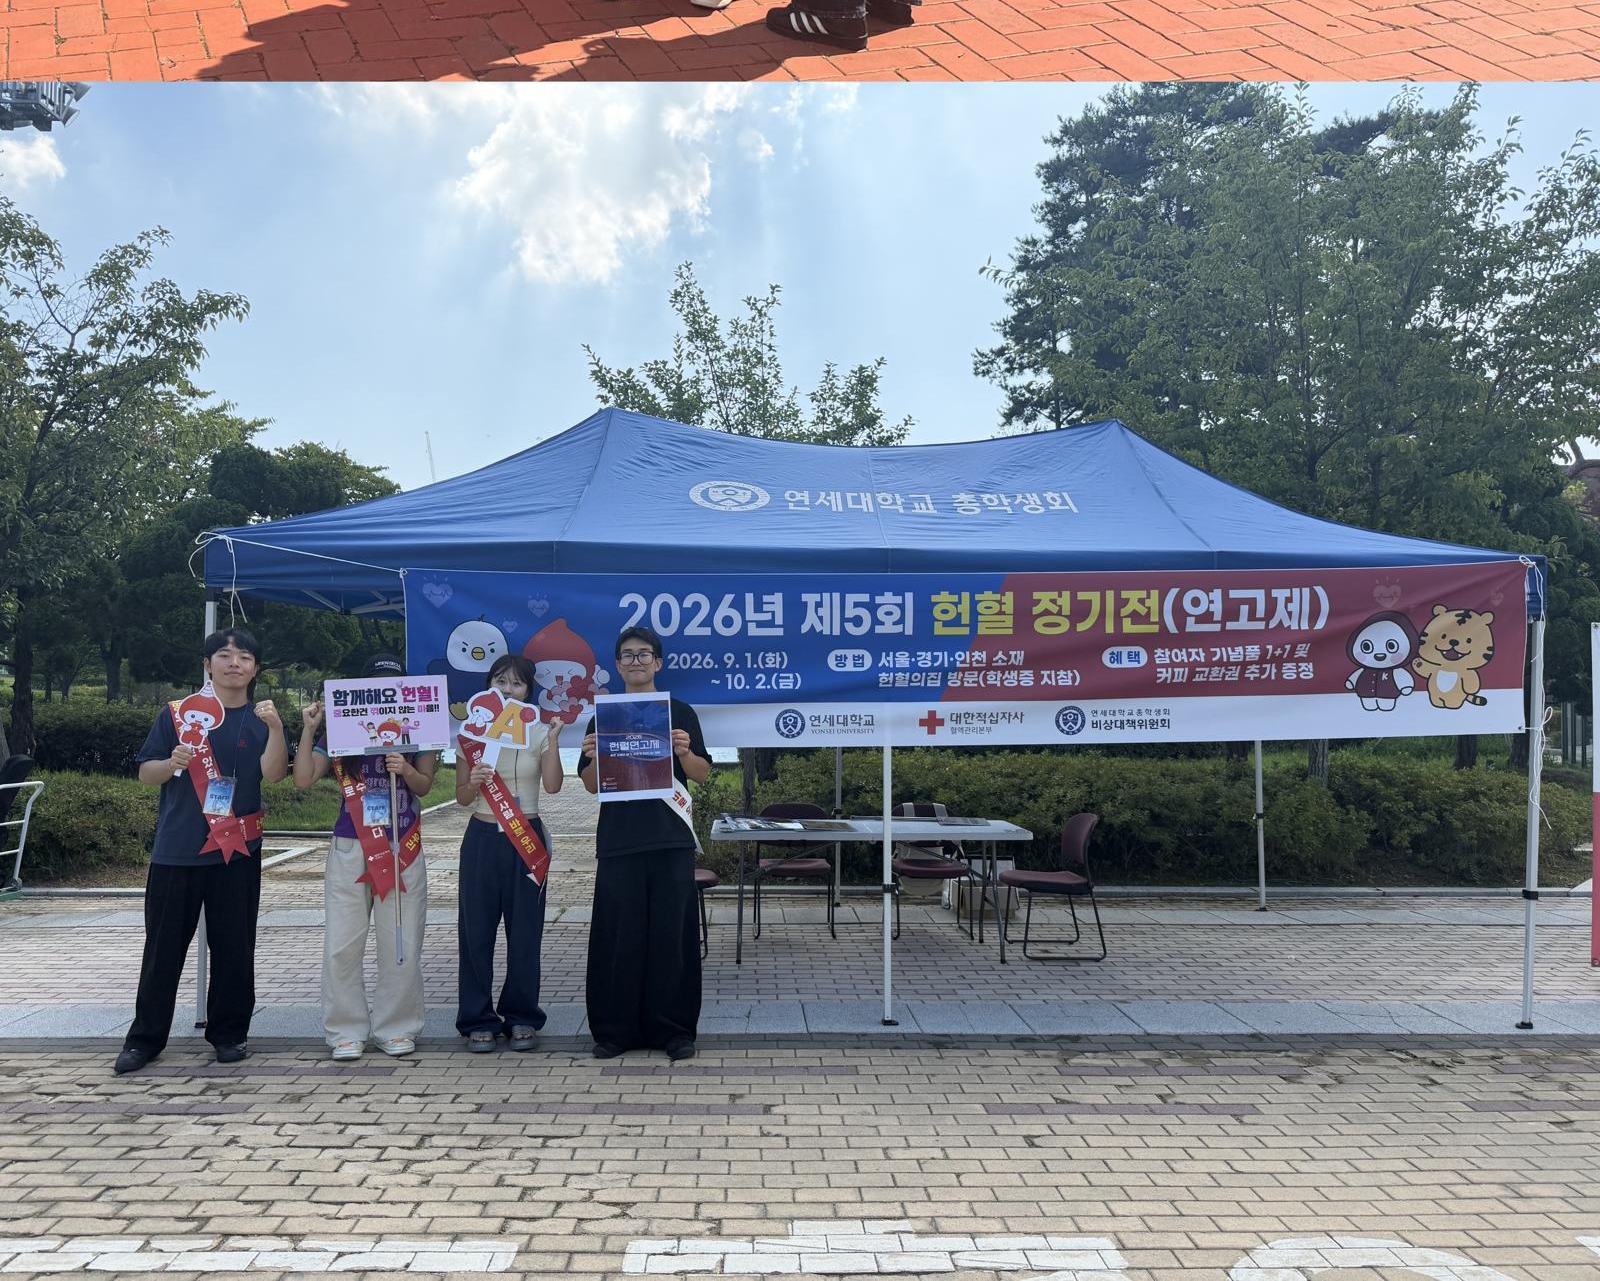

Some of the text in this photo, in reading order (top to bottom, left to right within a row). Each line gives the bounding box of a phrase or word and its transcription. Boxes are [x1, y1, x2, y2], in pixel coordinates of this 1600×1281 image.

[784, 489, 938, 514] 연세대학교
[951, 490, 1080, 514] 총학생회
[618, 585, 1330, 637] 2026년 제5회 헌혈 정기전(연고제)
[667, 651, 788, 670] 2026. 9. 1.(화)
[878, 651, 987, 669] 서울·경기·인천
[991, 650, 1025, 667] 소재
[1153, 648, 1206, 664] 참여자
[1210, 644, 1262, 663] 기념품
[1265, 644, 1290, 659] 1+1
[726, 673, 750, 690] 10.
[755, 672, 802, 691] 2.(금)
[877, 668, 1082, 688] 헌혈의집 방문(학생증 지참)
[1156, 662, 1314, 684] 커피 교환권 추가 증정
[1381, 671, 1389, 681] K
[332, 685, 439, 707] 함께해요 헌혈!
[808, 714, 875, 728] 연세대학교
[949, 710, 1025, 724] 대한적십자사
[1091, 718, 1171, 731] 비상대책위원회
[810, 727, 875, 736] YONSEI UNIVERSITY
[950, 726, 993, 735] 혈액관리본부
